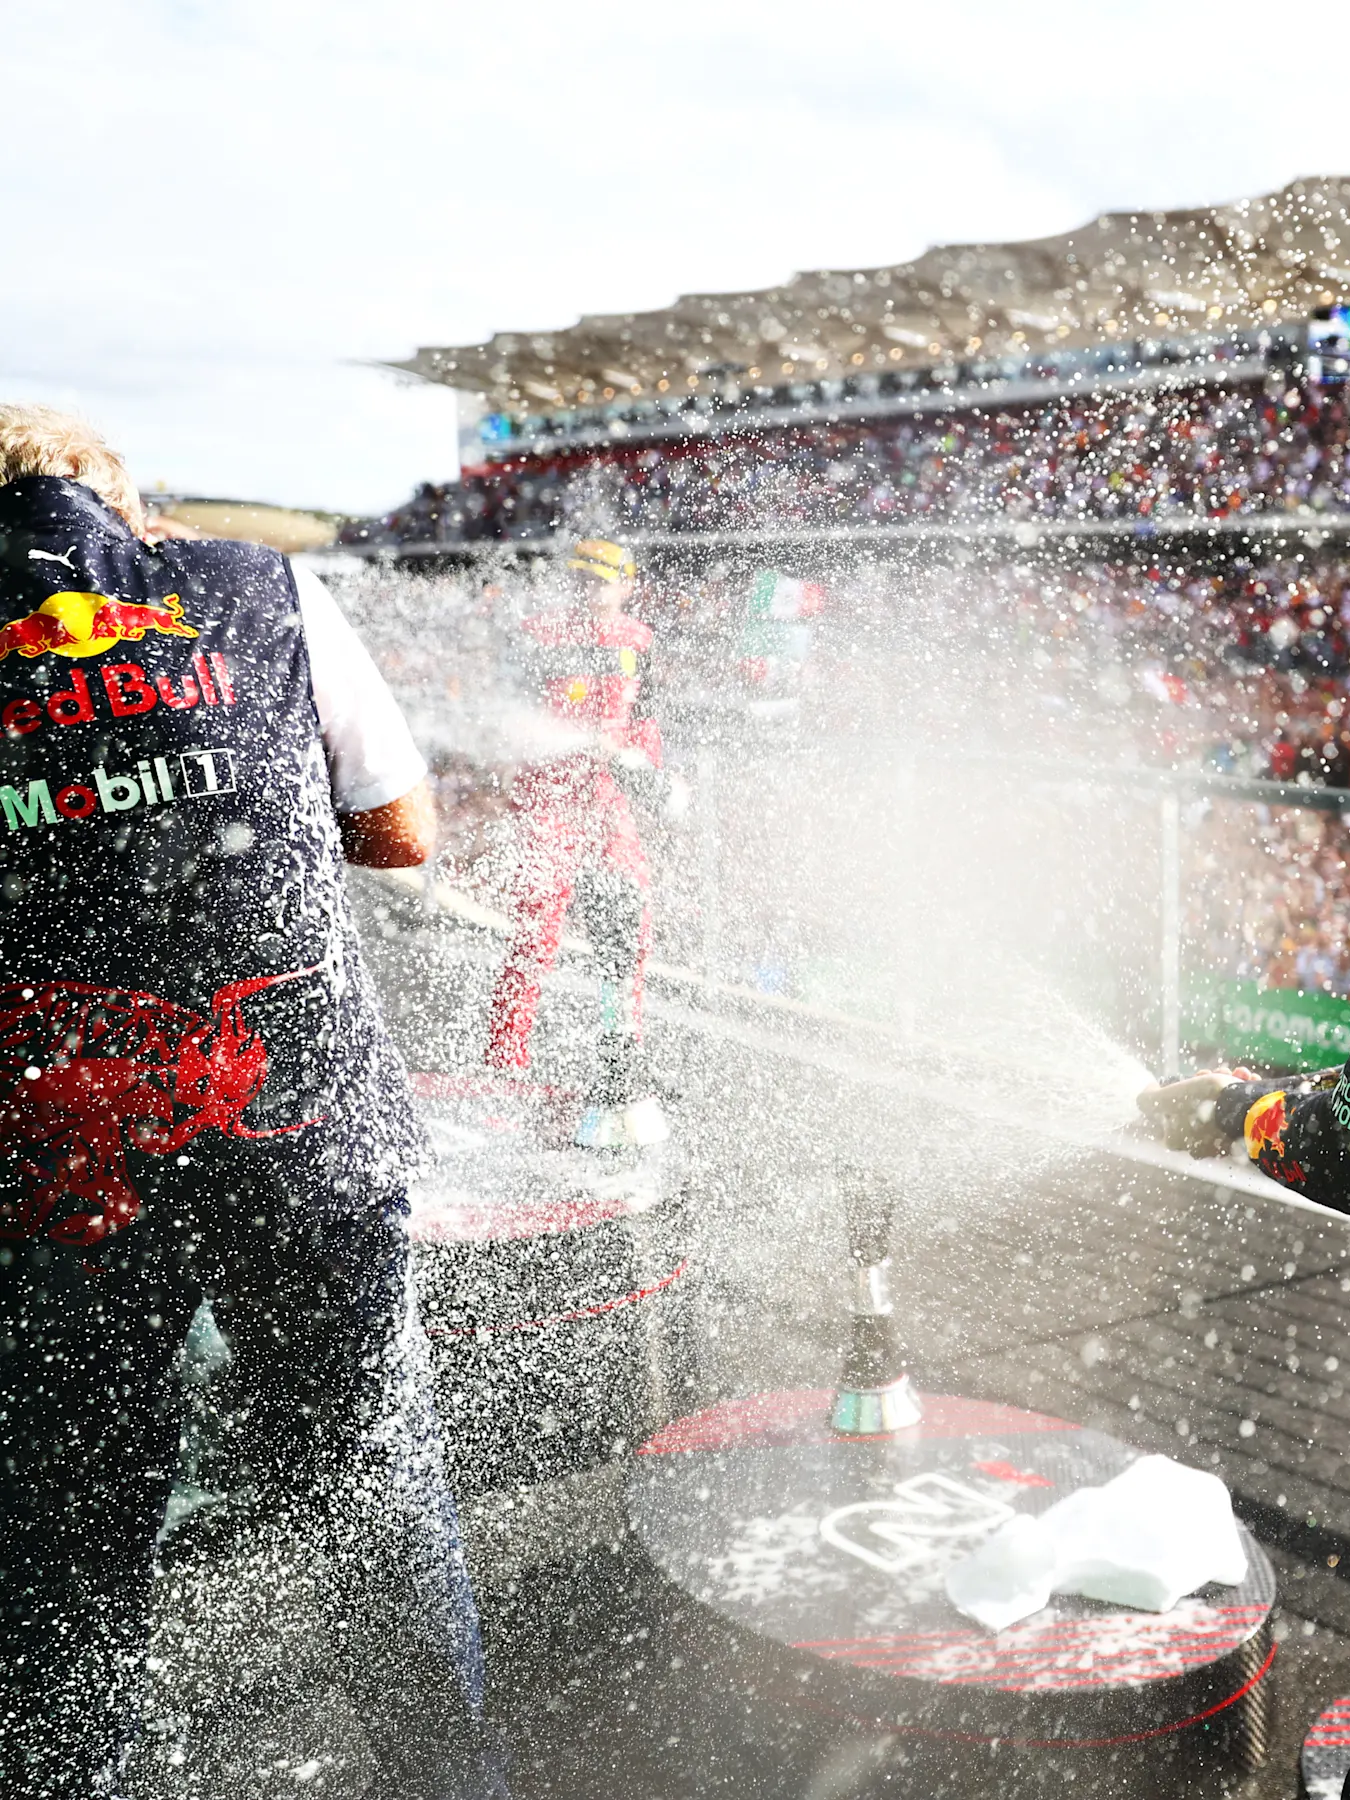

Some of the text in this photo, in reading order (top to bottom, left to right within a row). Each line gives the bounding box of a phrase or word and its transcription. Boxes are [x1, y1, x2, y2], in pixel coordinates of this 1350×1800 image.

[0, 652, 236, 738] ed Bull
[0, 757, 174, 831] Mobil
